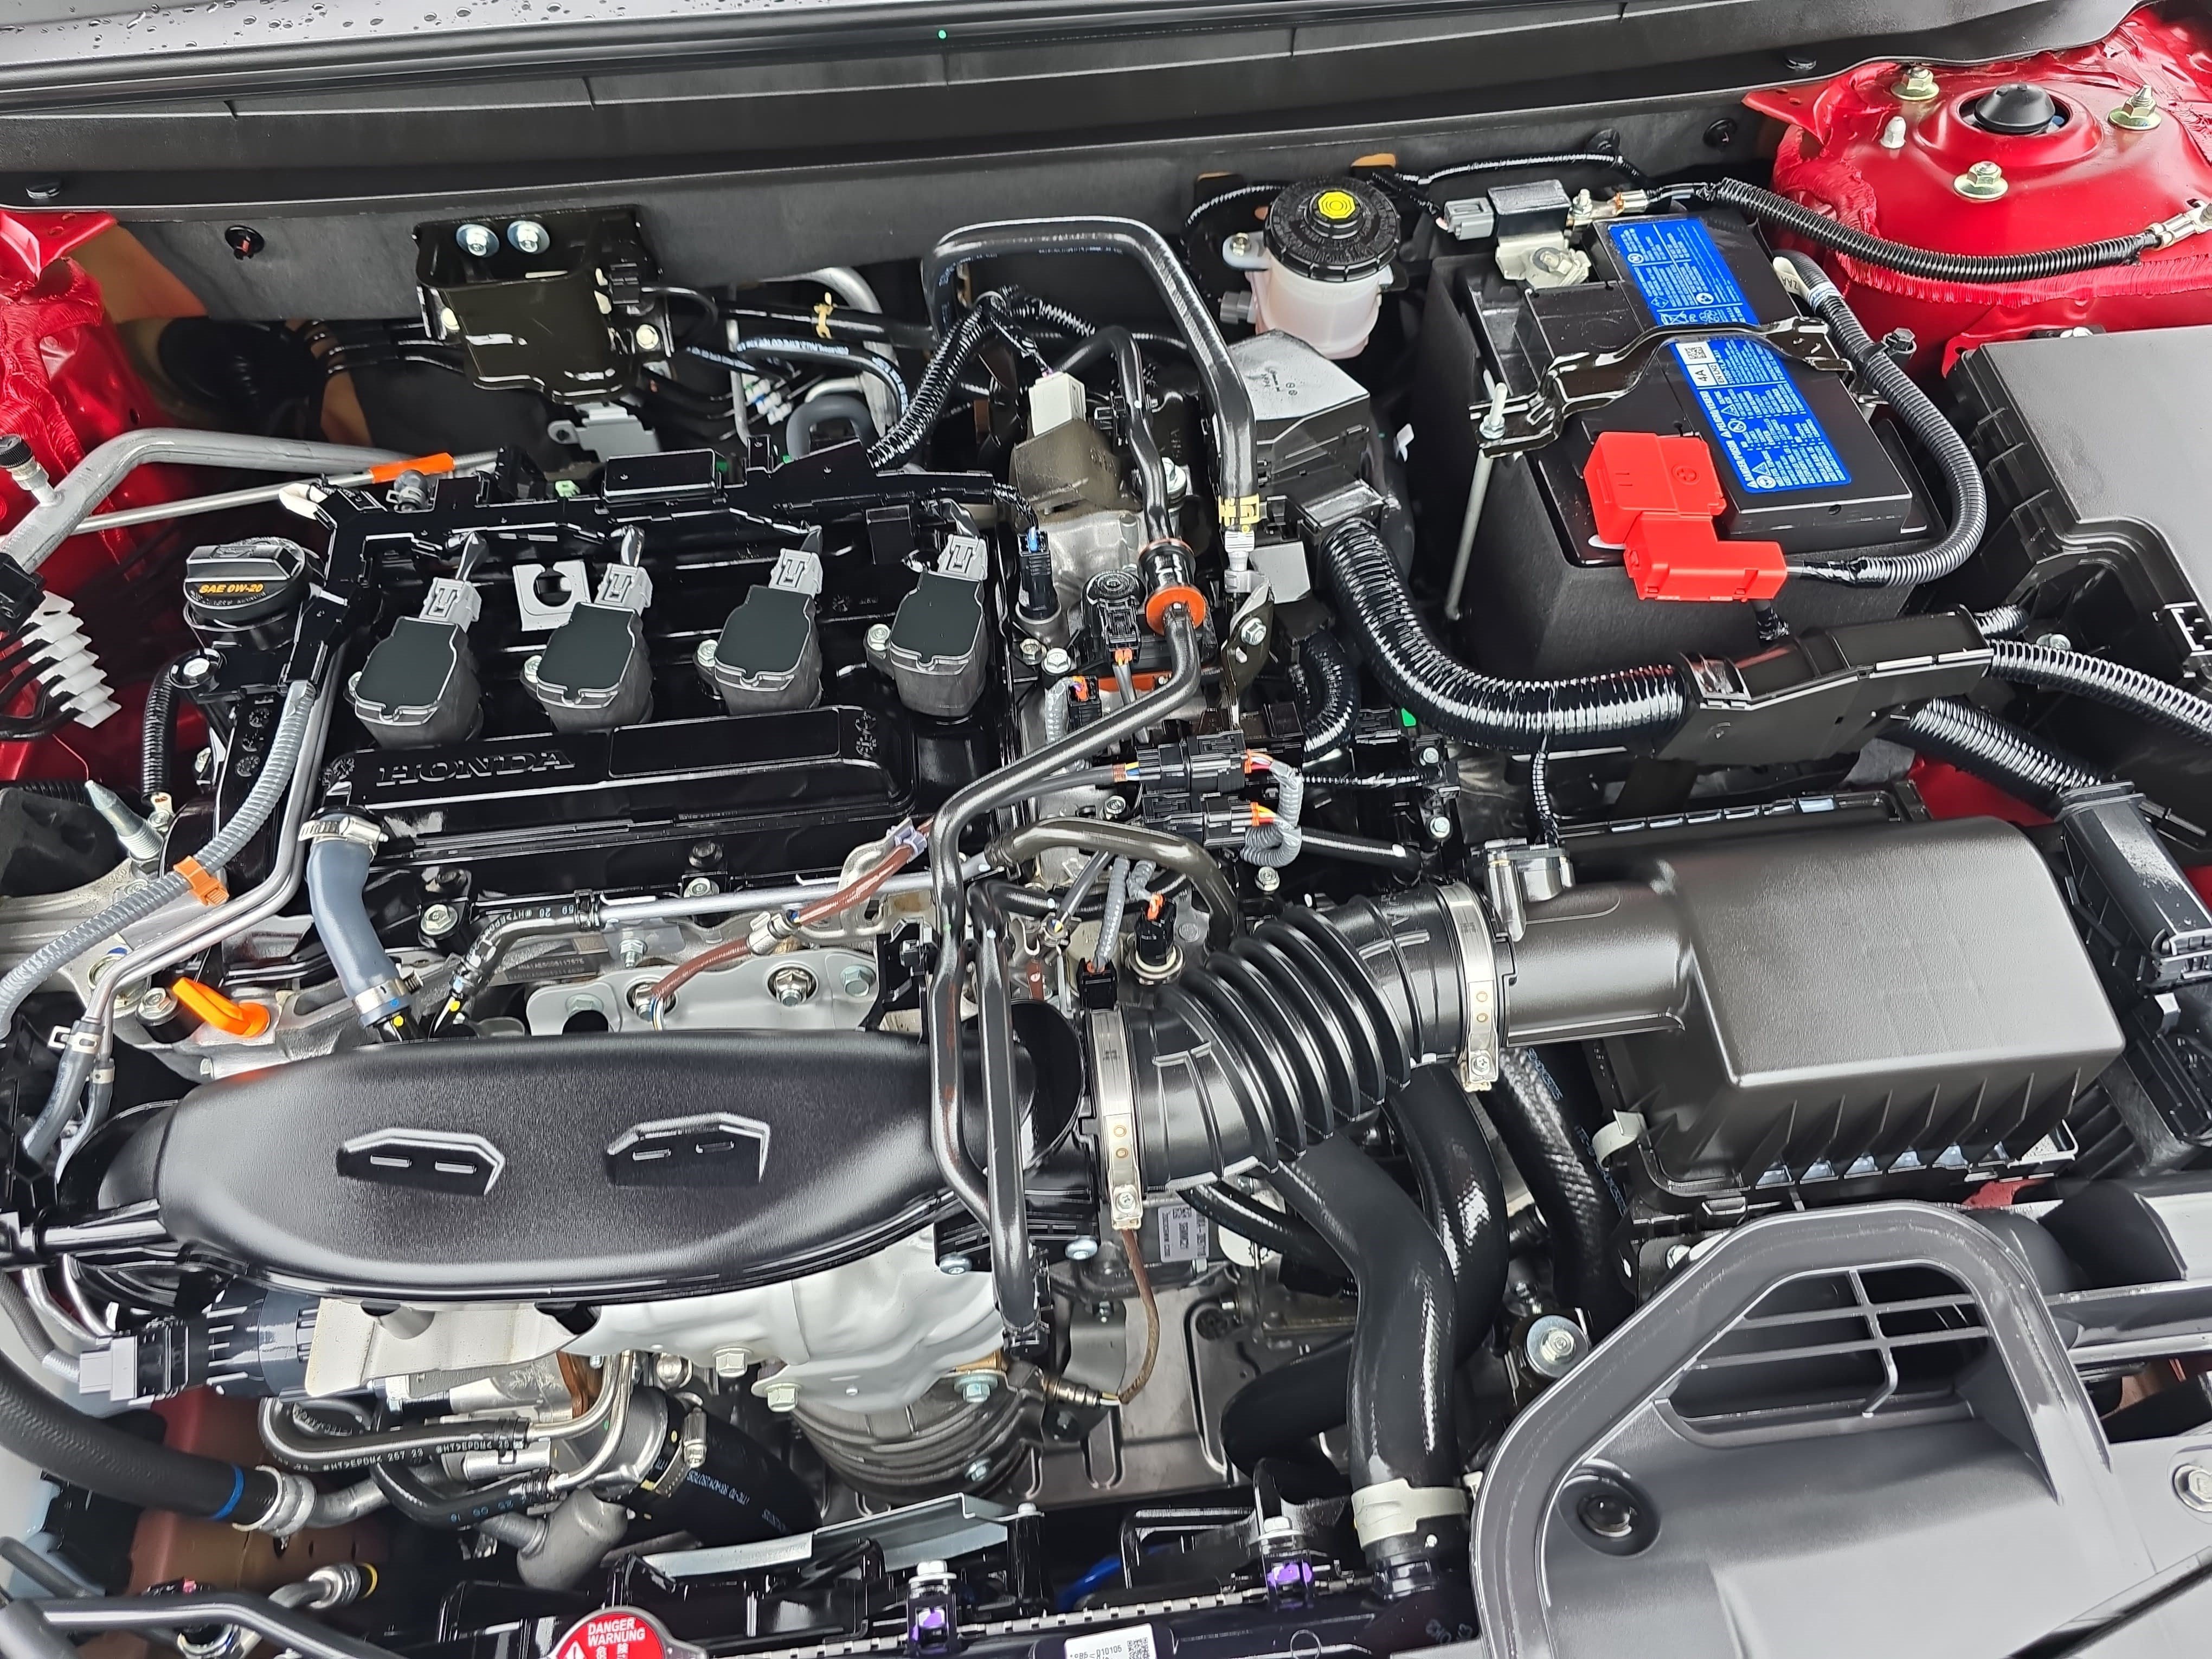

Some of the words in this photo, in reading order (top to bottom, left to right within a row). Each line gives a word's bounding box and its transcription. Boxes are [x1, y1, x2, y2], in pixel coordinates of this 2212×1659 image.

[1696, 369, 1709, 382] 4A
[1711, 364, 1720, 374] LN2
[1725, 440, 1756, 481] DANGER/POISON
[198, 583, 227, 594] SAE
[227, 583, 264, 594] 0W-20
[376, 749, 575, 787] HONDA
[588, 1617, 635, 1634] DANGER
[588, 1626, 646, 1647] WARNUNG
